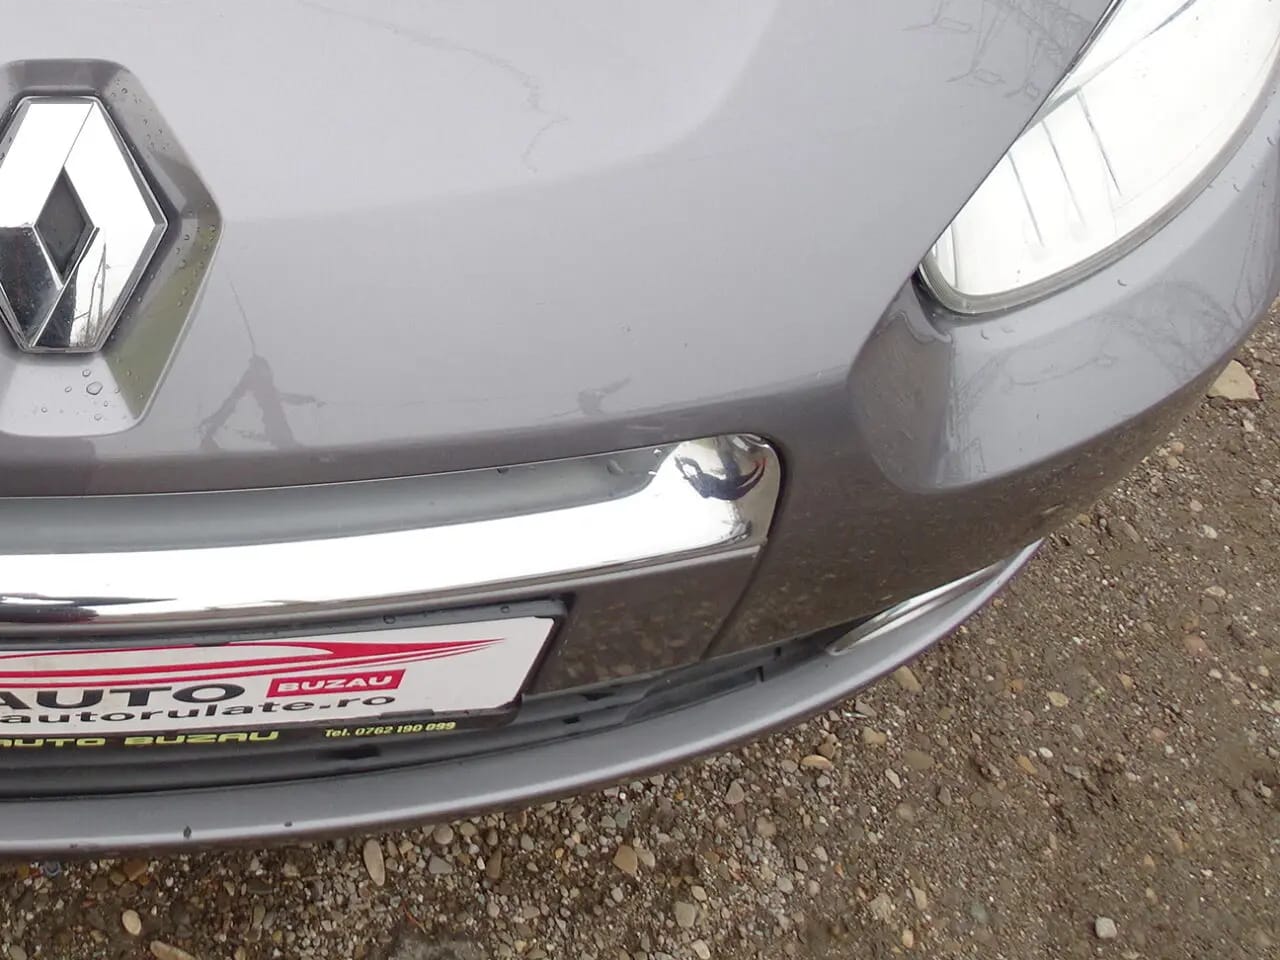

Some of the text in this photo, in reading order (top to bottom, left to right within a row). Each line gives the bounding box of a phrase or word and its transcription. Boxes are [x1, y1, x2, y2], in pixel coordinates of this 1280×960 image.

[277, 675, 393, 692] BUZAU
[325, 728, 351, 737] Tel.
[355, 726, 394, 736] 0762
[397, 724, 421, 733] 190
[124, 731, 280, 745] BUZAU
